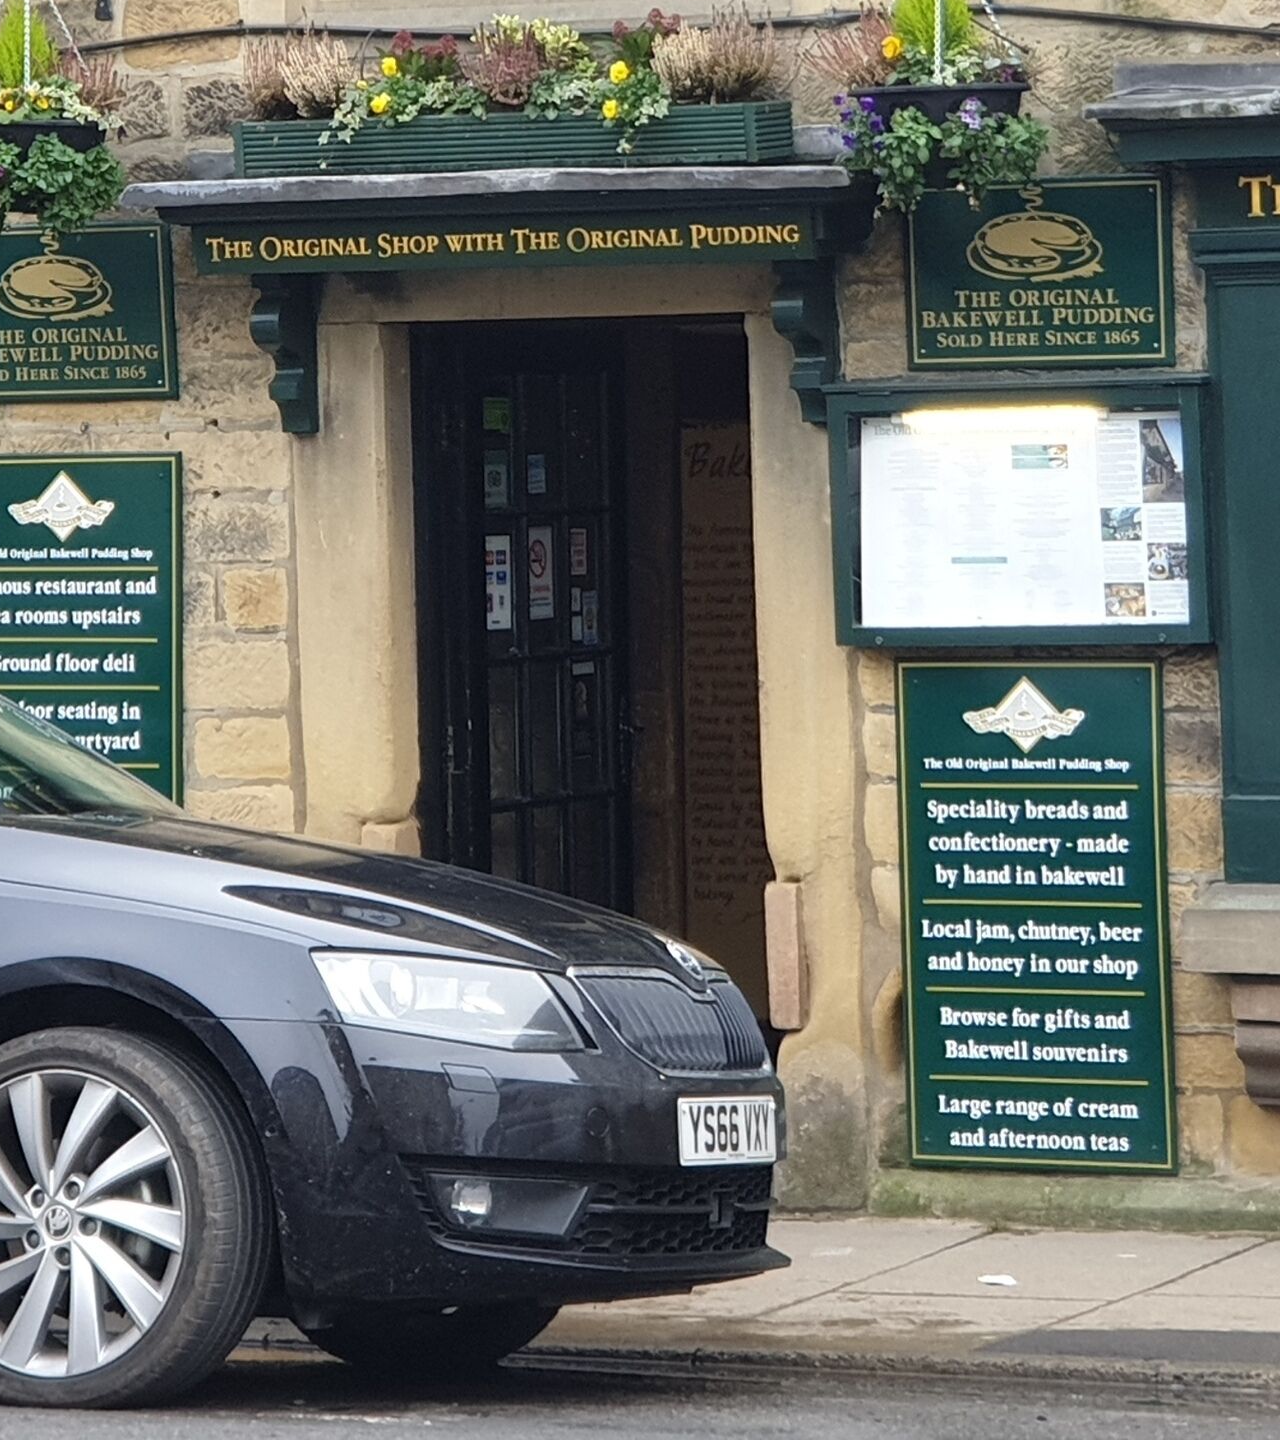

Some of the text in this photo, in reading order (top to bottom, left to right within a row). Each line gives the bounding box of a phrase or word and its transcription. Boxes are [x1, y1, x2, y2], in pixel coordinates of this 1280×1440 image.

[206, 224, 800, 261] THE ORIGINAL SHOP WITH THE ORIGINAL PUDDING
[955, 288, 1119, 308] THE ORIGINAL
[922, 306, 1155, 329] BAKEWELL PUDDING
[32, 327, 127, 343] ORIGINAL
[937, 329, 1140, 348] SOLD HERE SINCE 1865
[70, 344, 159, 361] PUDDING
[16, 367, 58, 380] HERE
[64, 366, 109, 379] SINCE
[115, 365, 146, 380] 1865
[10, 548, 47, 560] Original
[50, 548, 89, 559] Bakewell
[92, 548, 128, 561] Pudding
[131, 548, 152, 560] Shop
[35, 578, 121, 594] restaurant
[126, 577, 156, 594] and
[15, 609, 68, 624] rooms
[72, 606, 141, 629] upstairs
[56, 652, 98, 672] floor
[103, 652, 135, 672] deli
[58, 701, 118, 724] seating
[122, 701, 141, 719] in
[75, 731, 140, 754] urtyard
[924, 759, 1129, 772] The Old Original Bakewell Pudding Shop
[927, 800, 1128, 825] Speciality breads and
[929, 833, 1060, 858] confectionery
[1077, 835, 1129, 853] made
[936, 865, 1125, 888] by hand in bakewell
[922, 919, 1142, 947] Local jam, chutney, beer
[928, 953, 1139, 979] and honey in our shop
[940, 1007, 1129, 1032] Browse for gifts and
[944, 1040, 1128, 1064] Bakewell souvenirs
[938, 1096, 1139, 1121] Large range of cream
[689, 1104, 768, 1153] YS66 VXY
[950, 1128, 1129, 1151] and afternoon teas
